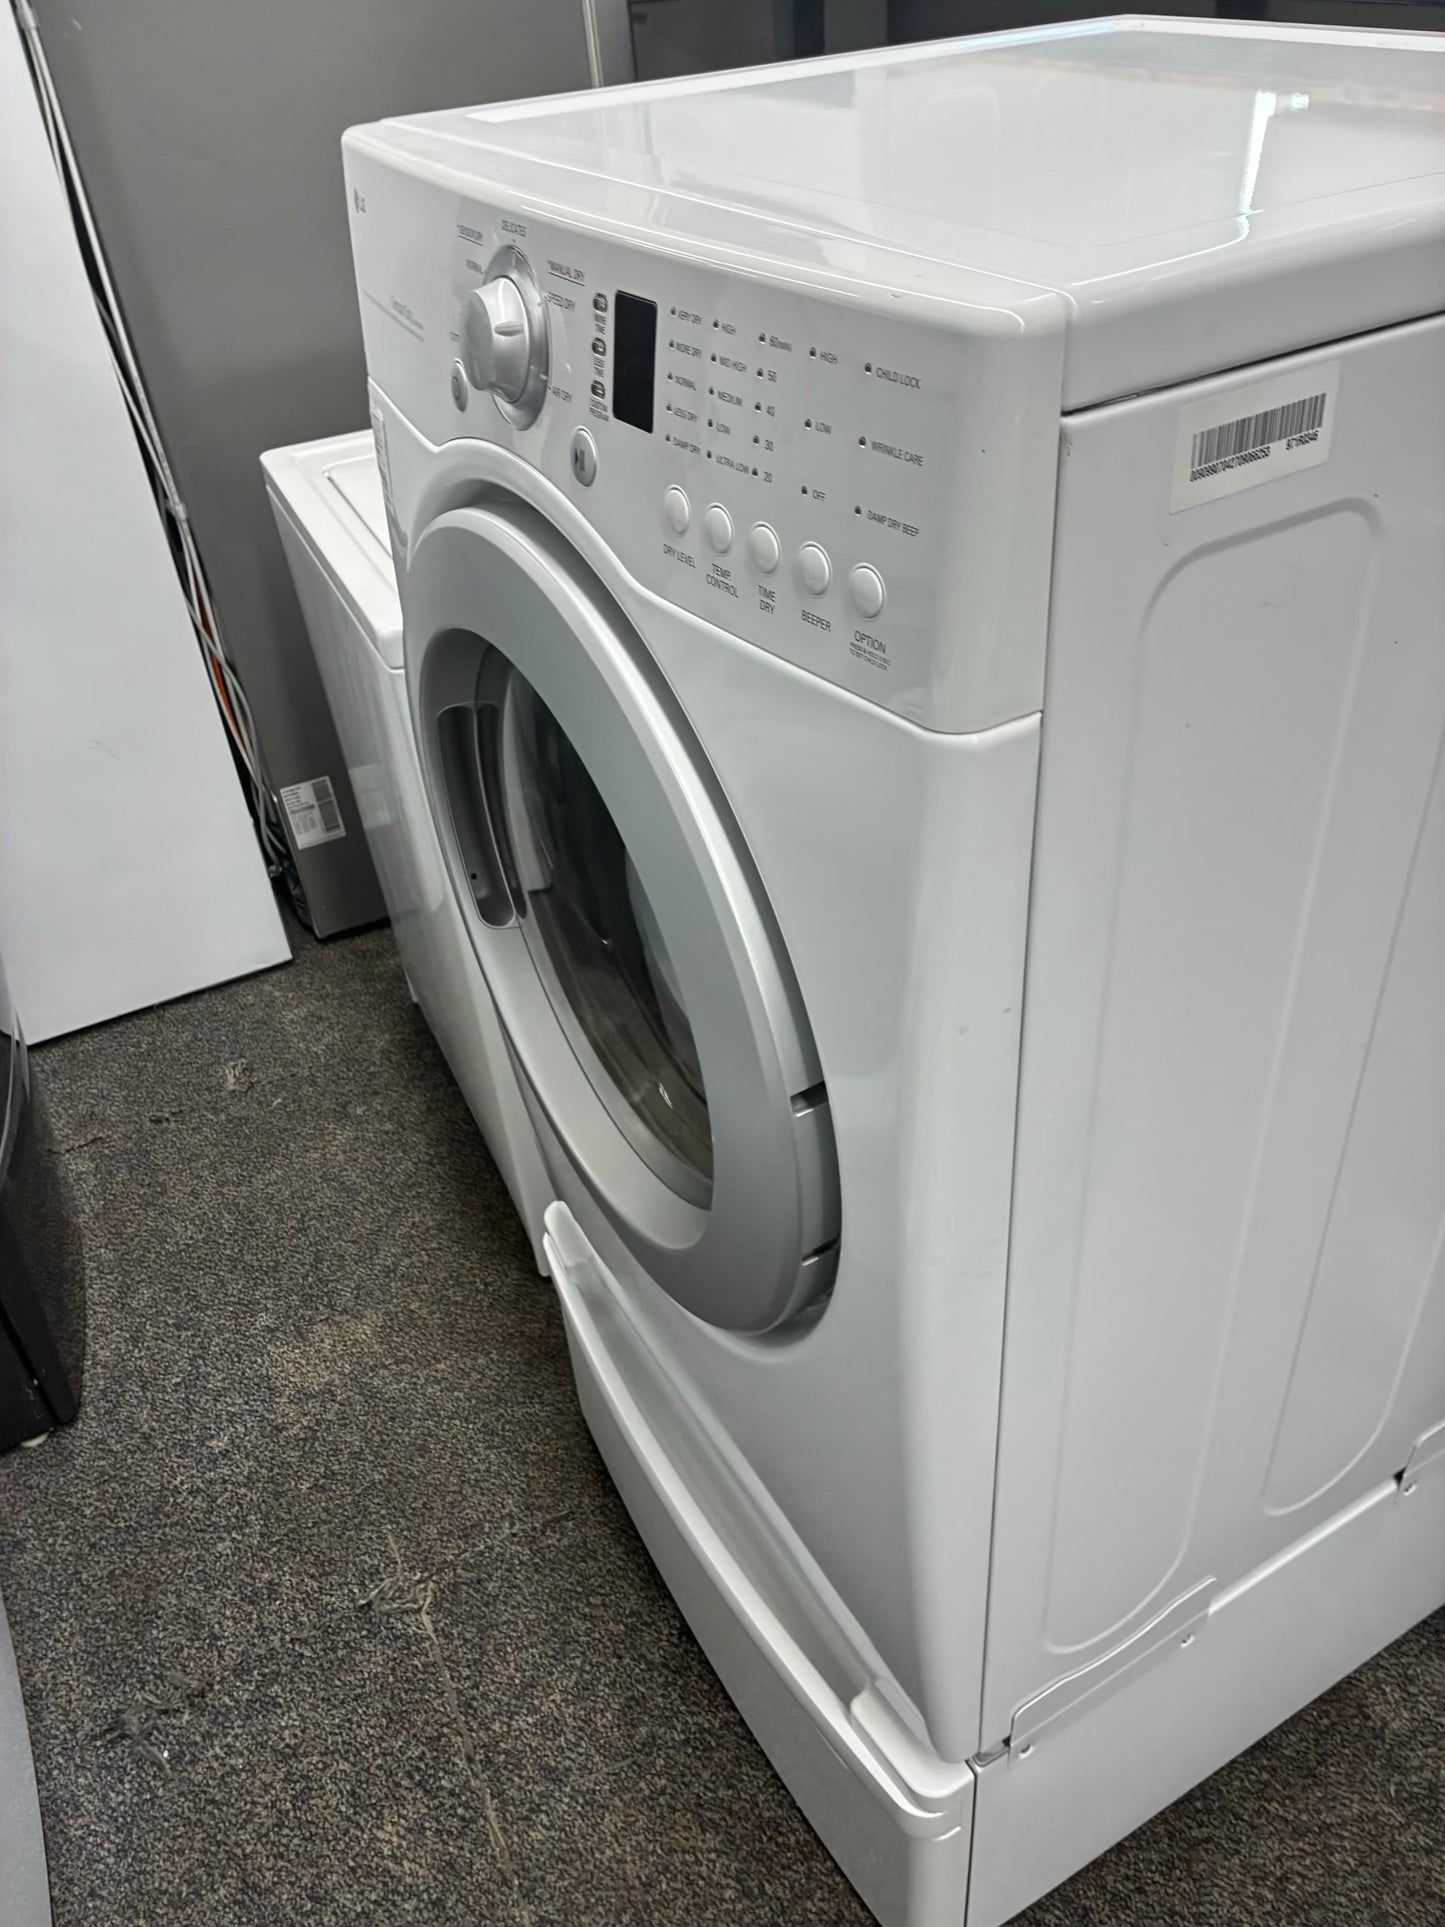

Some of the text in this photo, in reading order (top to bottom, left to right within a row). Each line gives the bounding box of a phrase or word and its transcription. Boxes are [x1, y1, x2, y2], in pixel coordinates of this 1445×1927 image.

[691, 313, 702, 326] DRY
[691, 346, 702, 359] DRY
[767, 369, 778, 383] 50
[876, 366, 921, 390] CHILD LOCK
[766, 405, 776, 418] 40
[764, 439, 775, 453] 30
[870, 440, 924, 468] WRINKLE CARE
[763, 471, 774, 484] 20
[812, 489, 827, 502] OFF
[868, 509, 920, 538] DAMP DRY BEEP
[663, 543, 697, 569] DRY LEVEL
[706, 573, 739, 599] CONTROL
[757, 584, 776, 603] TIME
[760, 599, 776, 615] DRY
[801, 608, 832, 633] BEEPER
[854, 630, 887, 655] OPTION
